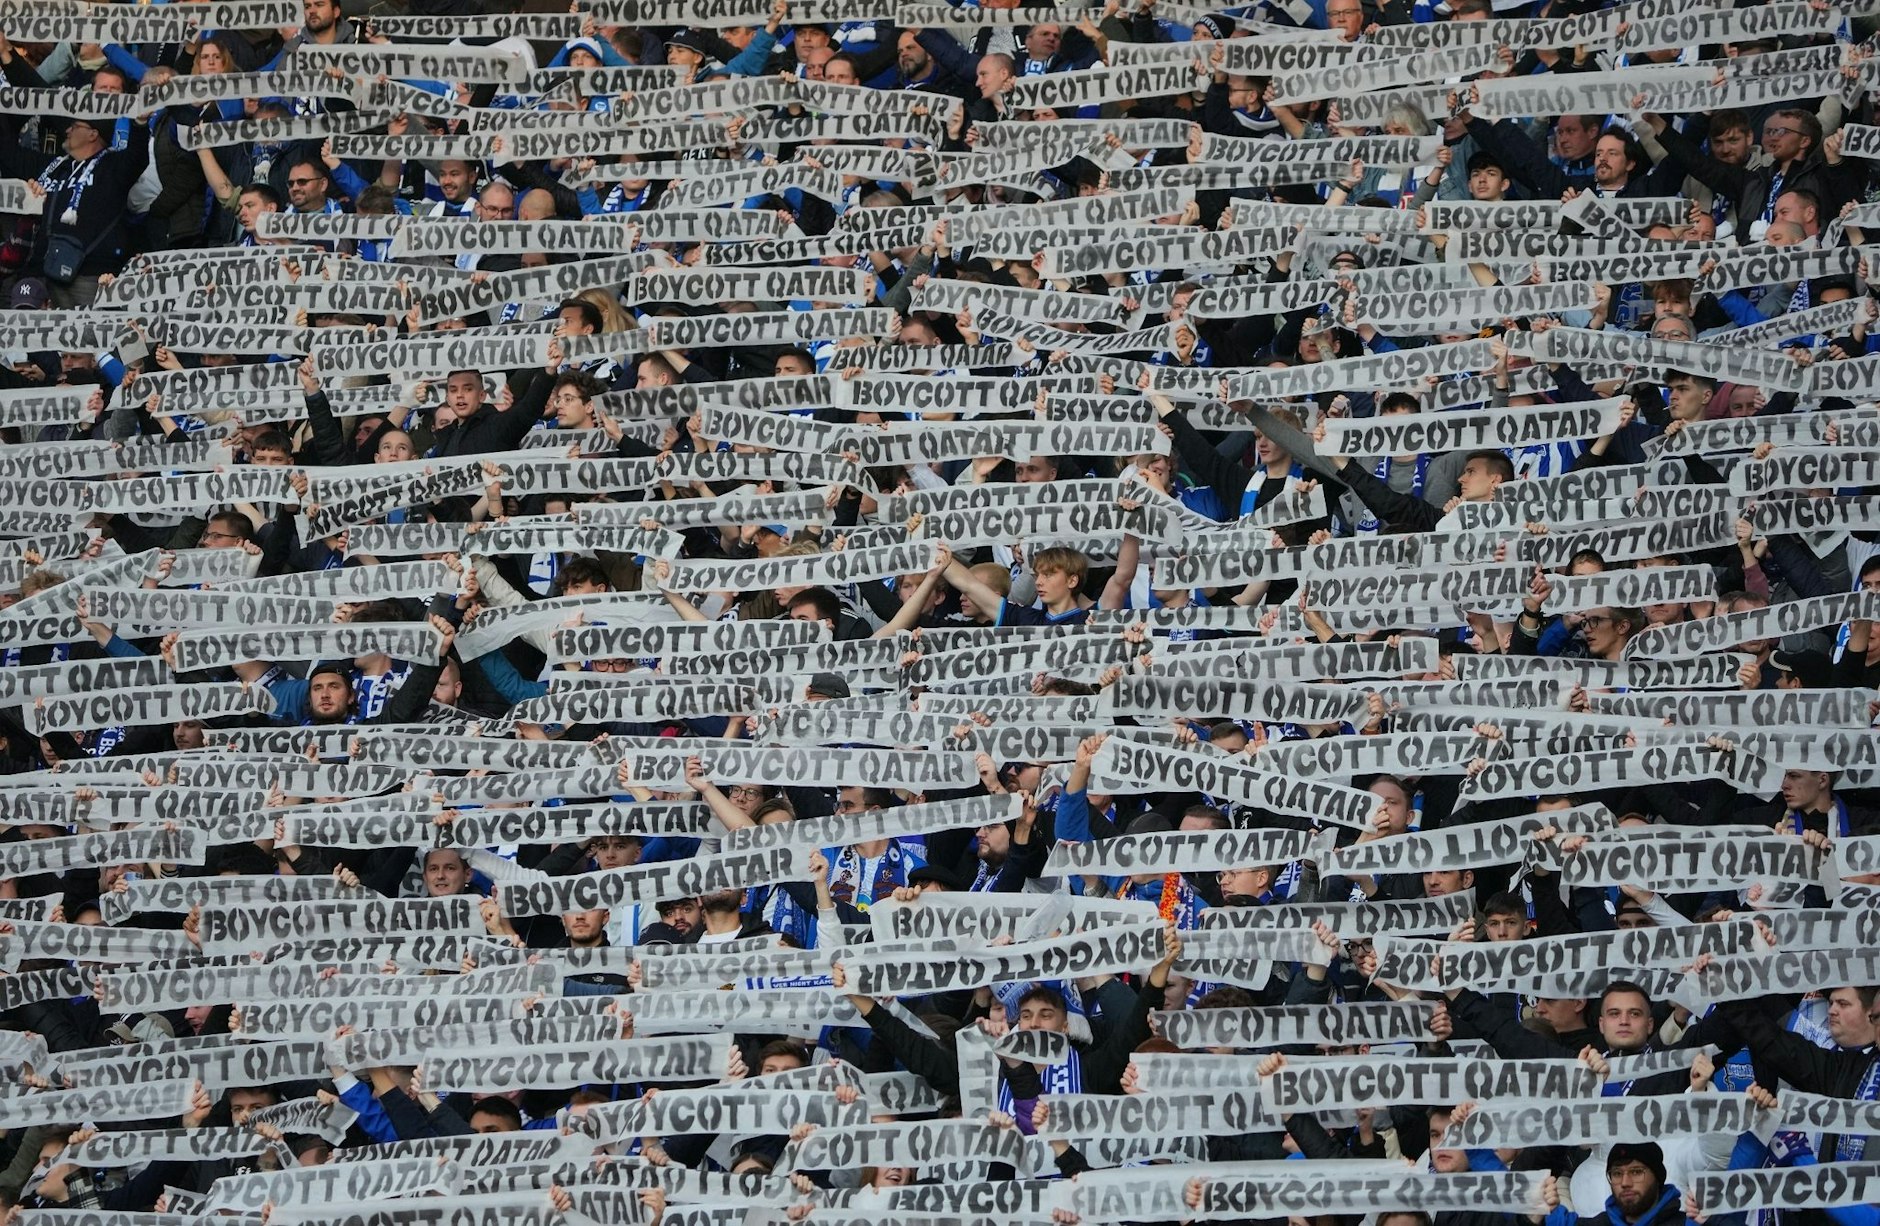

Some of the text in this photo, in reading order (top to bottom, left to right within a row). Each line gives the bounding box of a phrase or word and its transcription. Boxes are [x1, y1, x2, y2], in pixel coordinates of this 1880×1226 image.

[0, 17, 197, 41] OYCOTT QATAR
[216, 2, 297, 28] QATAR
[370, 14, 580, 37] BOYCOTT QATAR
[1740, 7, 1831, 31] QATAR
[299, 51, 507, 81] BOYCOTT QATAR
[1272, 44, 1497, 97] BOYCOTT QATAR
[1752, 46, 1841, 75] QATAR
[144, 70, 356, 105] BOYCOTT QATAR
[590, 67, 677, 92] QATAR
[1115, 66, 1195, 95] QATAR
[62, 91, 136, 115] QATAR
[613, 85, 726, 120] BOYCOTT
[865, 90, 948, 115] QATAR
[188, 116, 312, 148] BOYCOTT
[331, 135, 458, 157] BOYCOTT
[513, 120, 726, 156] BOYCOTT QATAR
[1105, 119, 1189, 143] QATAR
[1208, 139, 1420, 163] BOYCOTT QATAR
[762, 170, 838, 195] QATAR
[1110, 166, 1243, 189] BOYCOTT
[1086, 190, 1178, 222] QATAR
[1234, 202, 1375, 231] BOYCOTT
[1431, 208, 1557, 229] BOYCOT
[265, 213, 379, 235] BOYCOTT
[407, 224, 624, 249] BOYCOTT QATAR
[704, 210, 787, 238] QATAR
[706, 226, 925, 265] BOYCOTT QATAR
[1057, 237, 1195, 272] BOYCOTT
[1203, 226, 1297, 258] QATAR
[1461, 231, 1612, 258] BOYCOTT
[195, 258, 279, 286] QATAR
[1550, 250, 1694, 281] BOYCOTT
[188, 285, 412, 310] BOYCOTT QATAR
[419, 251, 655, 317] BOYCOTT QATAR
[636, 268, 856, 297] BOYCOTT QATAR
[917, 284, 1131, 326] BOYCOTT QATAR
[1356, 284, 1593, 318] BOYCOTT QATAR
[162, 322, 291, 348] BOYCOTT
[657, 310, 889, 347] BOYCOTT QATAR
[976, 309, 1094, 349] BOYCOTT
[319, 340, 535, 369] BOYCOTT QATAR
[830, 343, 1011, 369] BOYCOTT QATAR
[122, 366, 244, 406] BOYCOTT
[603, 377, 830, 417] BOYCOTT QATAR
[853, 381, 994, 405] BOYCOTT
[706, 412, 832, 446] BOYCOTT
[1051, 425, 1154, 451] QATAR
[1340, 408, 1600, 453] BOYCOTT QATAR
[206, 470, 289, 497] QATAR
[408, 462, 482, 497] QATAR
[1745, 451, 1877, 490] BOYCOTT
[722, 497, 824, 523] QATAR
[924, 503, 1167, 540] BOYCOTT QATAR
[1459, 500, 1613, 528] BOYCOTT
[1649, 510, 1731, 548] QATAR
[670, 546, 927, 588] BOYCOTT QATAR
[1157, 539, 1418, 585] BOYCOTT QATAR
[349, 563, 445, 595] QATAR
[1305, 574, 1438, 606] BOYCOTT
[89, 592, 335, 624] BOYCOTT QATAR
[177, 628, 438, 668] BOYCOTT QATAR
[557, 622, 819, 654] BOYCOTT QATAR
[670, 652, 807, 676] BOYCOTT
[1313, 642, 1427, 677] QATAR
[1627, 655, 1739, 687] QATAR
[36, 690, 172, 730] BOYCOTT
[508, 688, 649, 719] BOYCOTT
[655, 684, 752, 716] QATAR
[1113, 677, 1367, 721] BOYCOTT QATAR
[1451, 681, 1558, 709] QATAR
[1752, 692, 1868, 724] QATAR
[178, 763, 319, 789] BOYCOTT
[703, 751, 966, 782] BOYCOTT QATAR
[1460, 745, 1767, 795] BOYCOTT QATAR
[1111, 746, 1374, 825] BOYCOTT QATAR
[154, 792, 265, 818] QATAR
[302, 815, 431, 845] BOYCOT
[436, 805, 711, 848] BOYCOTT QATAR
[729, 795, 1009, 850] BOYCOTT QATAR
[86, 829, 196, 861] QATAR
[1053, 835, 1207, 872] BOYCOTT
[1563, 847, 1705, 883] OYCOTT
[504, 850, 792, 915] BOYCOTT QATAR
[205, 899, 470, 941] BOYCOTT QATAR
[1356, 899, 1468, 934] QATAR
[642, 950, 822, 988] BOYCOTT
[992, 925, 1164, 982] BOYCOTT
[1441, 921, 1754, 985] BOYCOTT QATAR
[101, 967, 261, 1003] BOYCOTT
[858, 955, 985, 993] QATAR
[1701, 948, 1880, 995] BOYCOTT
[241, 1002, 407, 1034] BOYCOTT
[509, 1015, 618, 1045] QATAR
[1154, 1003, 1432, 1043] BOYCOTT QATAR
[426, 1043, 711, 1088] BOYCOTT QATAR
[1274, 1061, 1598, 1106] BOYCOTT QATAR
[1051, 1097, 1212, 1134] BOYCOTT
[1450, 1103, 1626, 1145] BOYCOTT
[892, 1181, 1048, 1213] BOYCOT
[1203, 1172, 1531, 1213] BOYCOTT QATAR
[1696, 1165, 1880, 1208] BOYCOT
